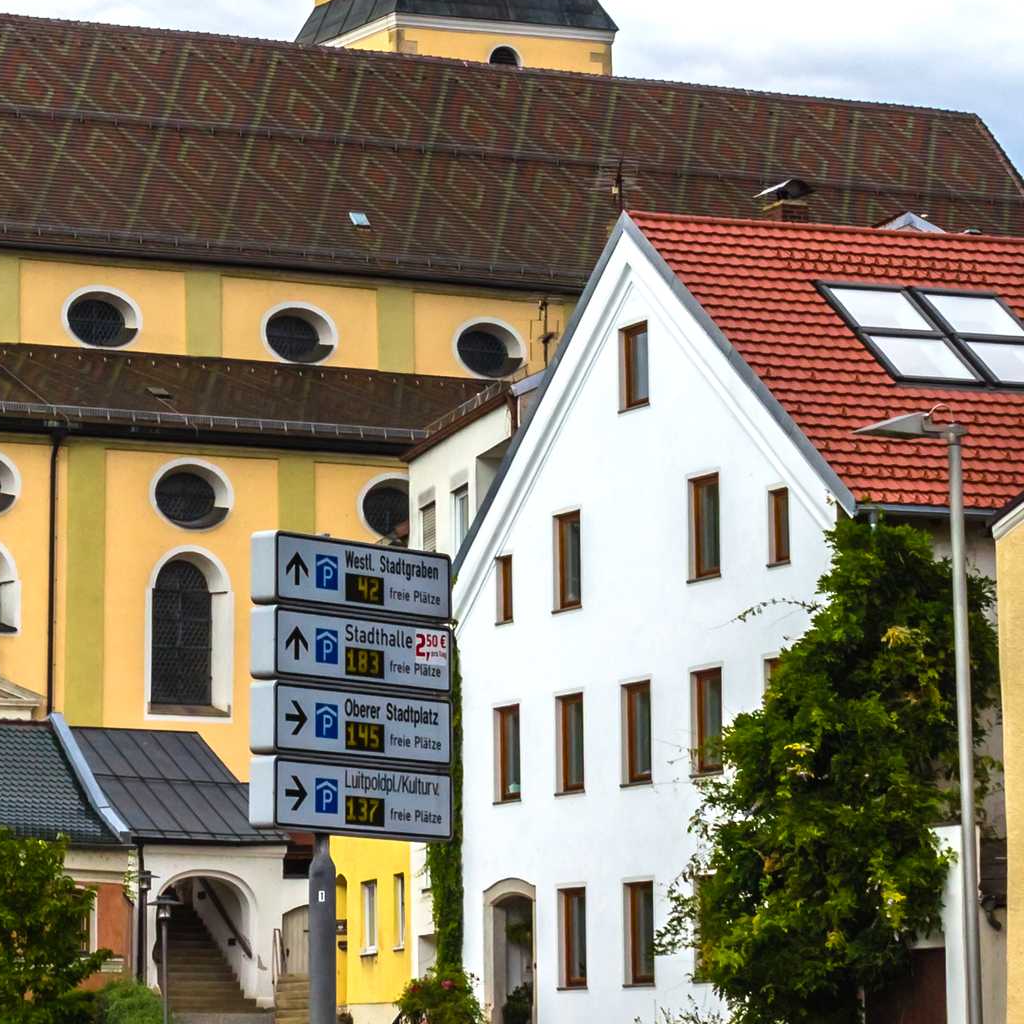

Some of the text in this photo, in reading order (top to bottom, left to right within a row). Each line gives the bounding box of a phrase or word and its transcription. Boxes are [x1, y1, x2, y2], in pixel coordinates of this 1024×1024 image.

[345, 550, 439, 581] Westl. Stadtgraben
[358, 576, 380, 602] 42
[389, 587, 441, 606] freie Plätze
[345, 624, 413, 649] Stadthalle
[346, 650, 380, 674] 183
[389, 660, 441, 678] freie Plätze
[344, 698, 439, 727] Oberer Stadtplatz
[346, 723, 380, 748] 145
[390, 733, 442, 751] freie Plätze
[346, 797, 379, 822] 137
[390, 807, 442, 825] freie Plätze
